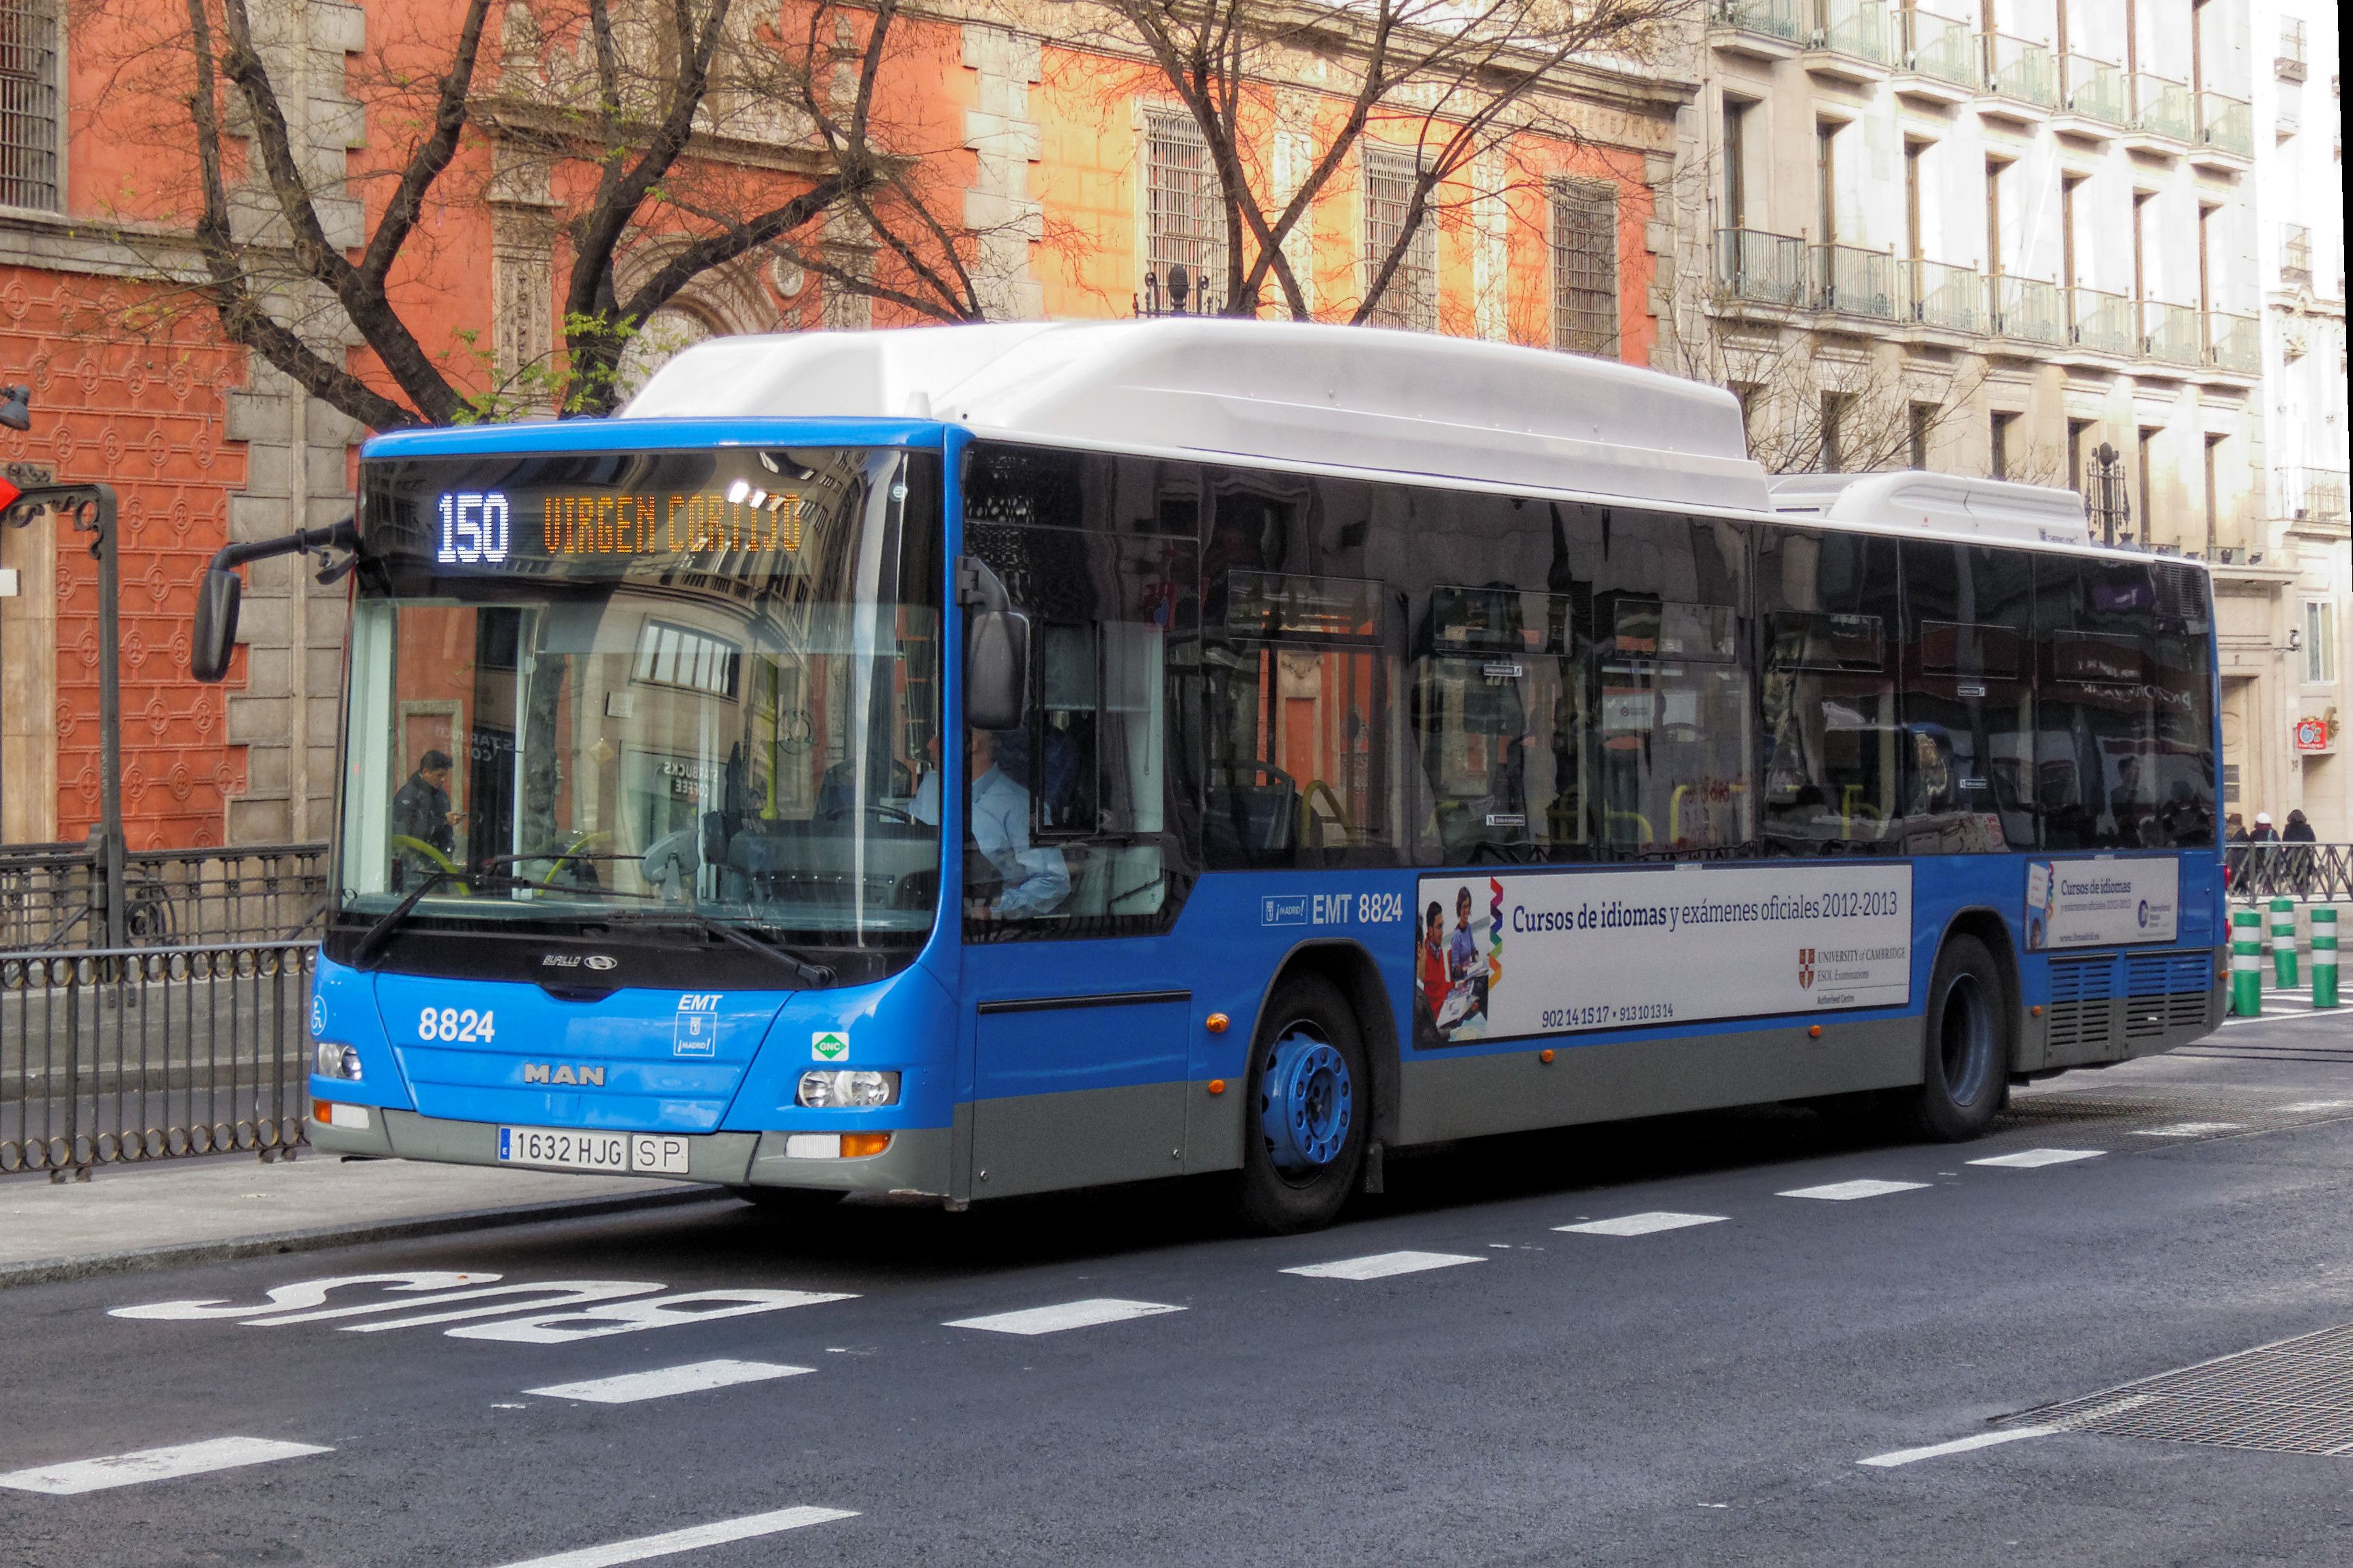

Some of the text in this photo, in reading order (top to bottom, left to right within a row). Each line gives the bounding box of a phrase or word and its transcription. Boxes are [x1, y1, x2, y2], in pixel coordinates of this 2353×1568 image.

[439, 493, 800, 563] 150 VIRGEN CORTIJO
[2061, 879, 2089, 896] Cursos
[2090, 879, 2099, 894] de
[2100, 878, 2131, 894] idiomas
[1312, 893, 1403, 924] EMT 8824
[1513, 891, 1897, 932] Cursos de idiomas y exámenes oficiales 2012-2013
[1818, 950, 1859, 963] UNIVERSITY
[1865, 947, 1906, 962] CAMBRIDGE
[1818, 969, 1833, 982] ESOL
[677, 995, 723, 1011] EMT
[418, 1007, 495, 1044] 8824
[1542, 1010, 1564, 1029] 902
[1566, 1008, 1579, 1026] 14
[1581, 1007, 1594, 1025] 15
[1596, 1006, 1609, 1023] 17
[819, 1042, 841, 1051] GNC
[524, 1063, 605, 1086] MAN
[518, 1132, 621, 1165] 1632 HJG
[107, 1270, 862, 1344] BUS
